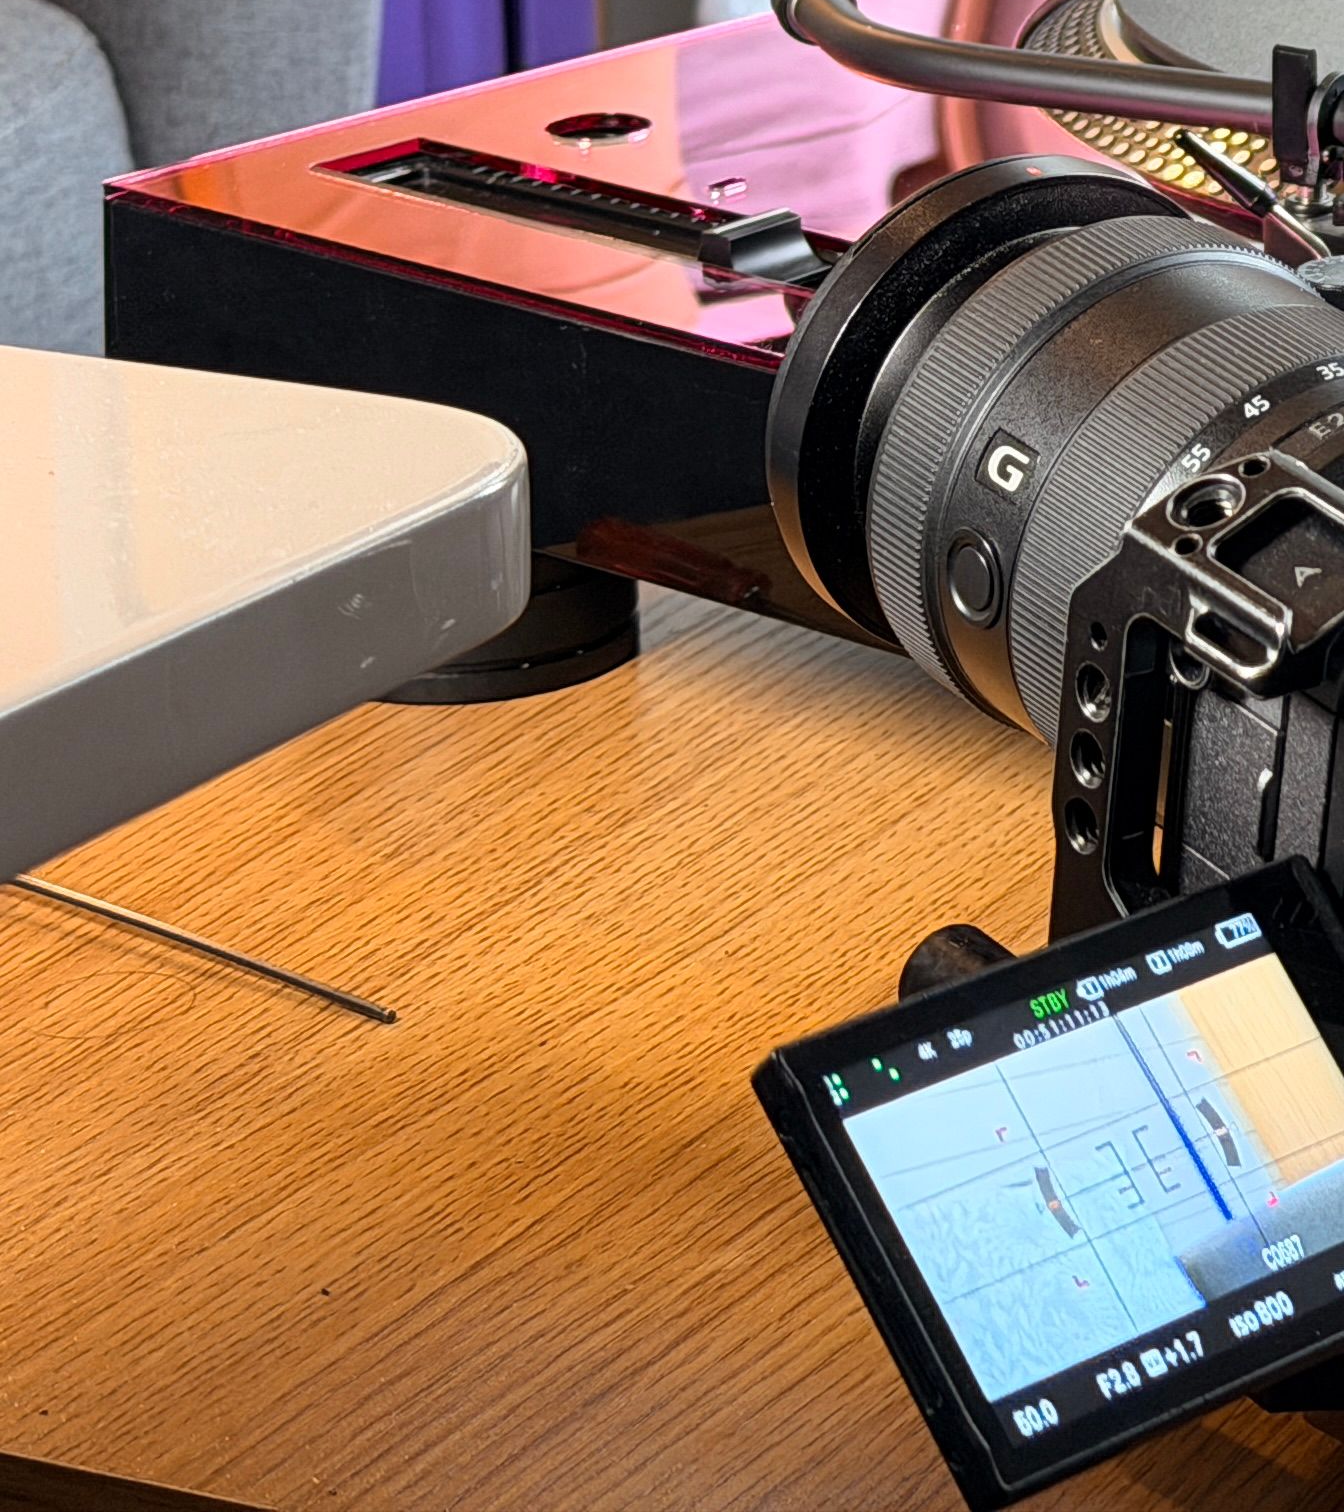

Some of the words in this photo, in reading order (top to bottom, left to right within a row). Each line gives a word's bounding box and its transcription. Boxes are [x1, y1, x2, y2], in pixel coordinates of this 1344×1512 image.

[1243, 393, 1271, 420] 45
[1308, 421, 1332, 441] E
[987, 445, 1031, 492] G
[1181, 442, 1211, 474] 55
[1029, 987, 1070, 1021] STBY
[1095, 1360, 1143, 1401] F2.8
[1228, 1310, 1260, 1339] ISO
[1253, 1290, 1295, 1326] 800
